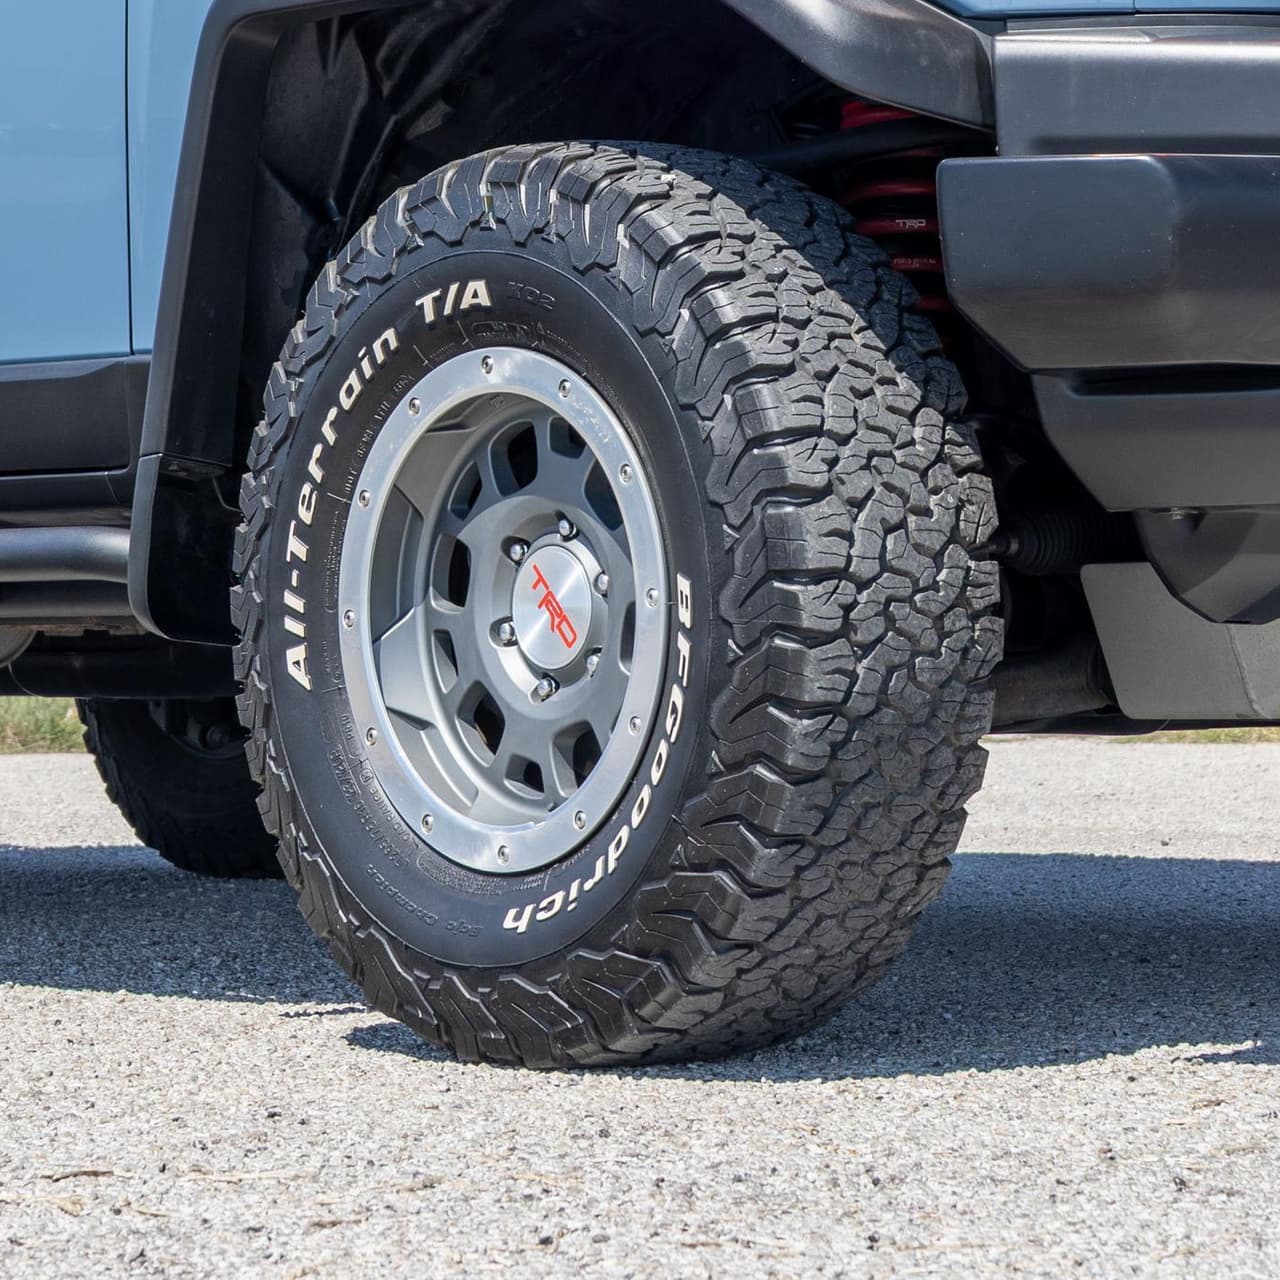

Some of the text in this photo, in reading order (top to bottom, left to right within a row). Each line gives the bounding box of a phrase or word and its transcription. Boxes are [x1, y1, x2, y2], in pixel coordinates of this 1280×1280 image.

[895, 219, 927, 229] TRD
[284, 325, 401, 691] All-Terrain
[415, 279, 492, 325] T/A
[531, 563, 577, 650] TRD
[502, 572, 694, 934] BFGoodrich
